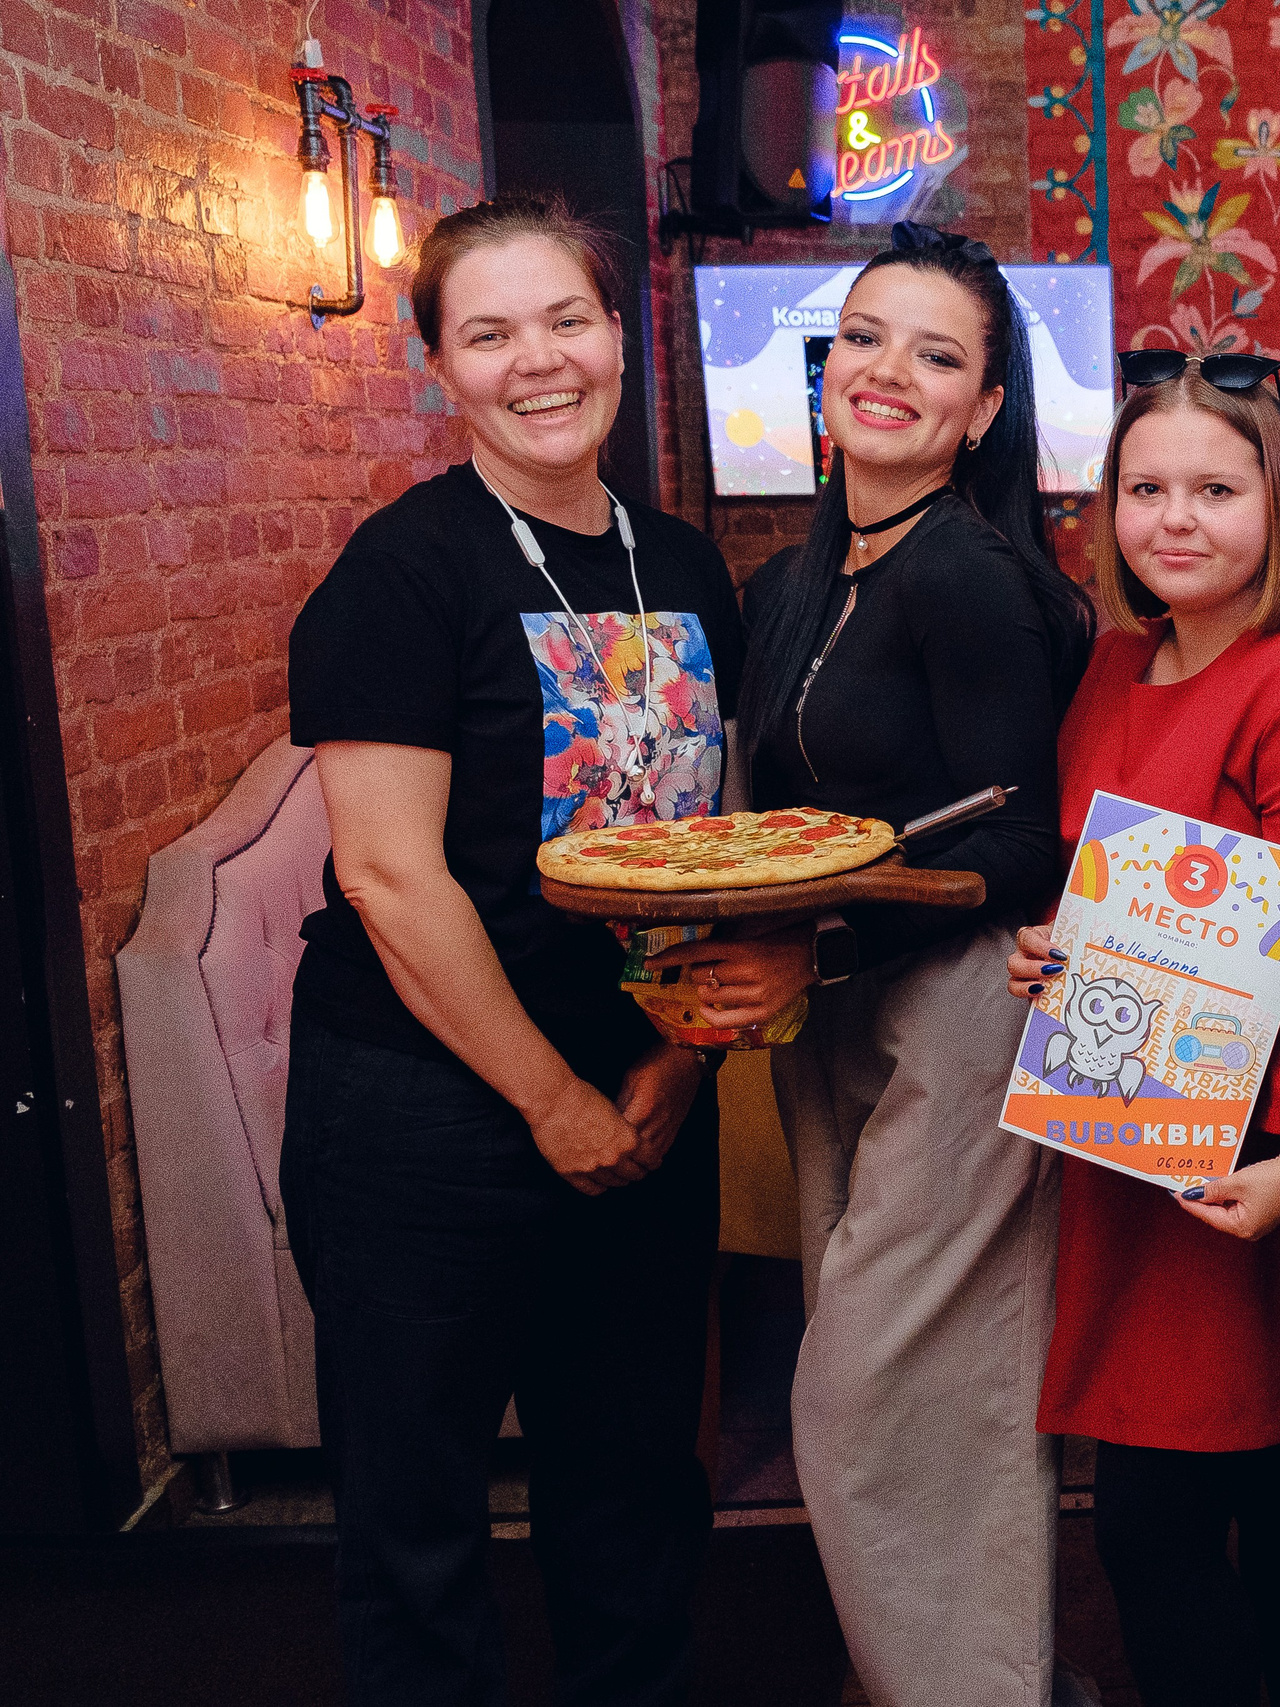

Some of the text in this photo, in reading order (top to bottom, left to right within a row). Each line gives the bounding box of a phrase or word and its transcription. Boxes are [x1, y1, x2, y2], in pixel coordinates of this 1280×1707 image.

[848, 110, 882, 150] &
[830, 120, 955, 198] eams
[1182, 860, 1210, 892] 3
[1127, 897, 1239, 947] МЕСТО
[1157, 931, 1199, 949] команде:
[1103, 934, 1199, 977] Belladonna
